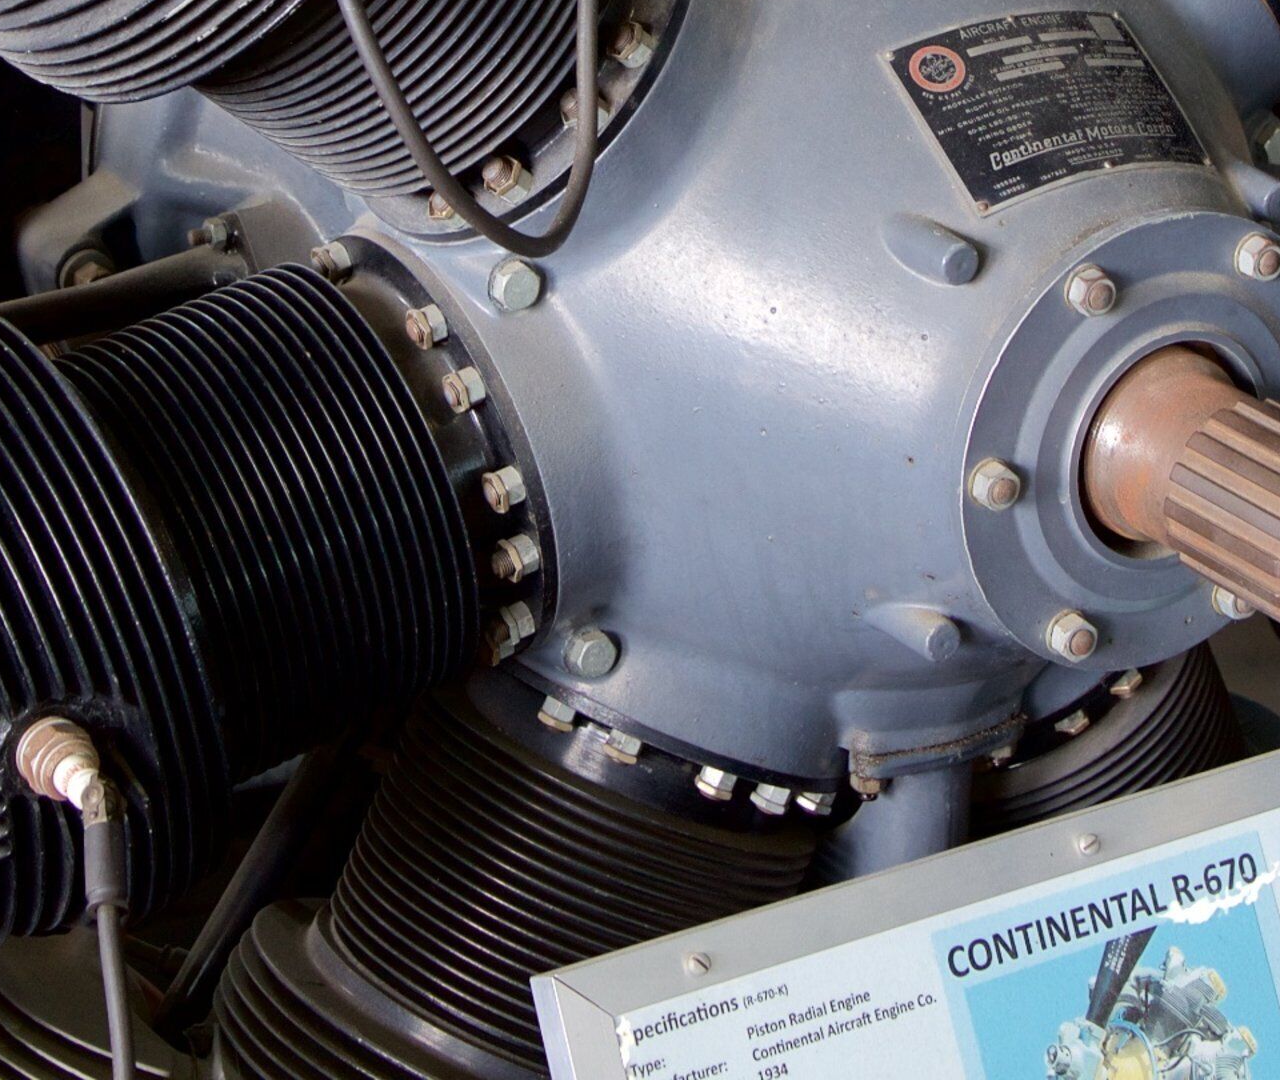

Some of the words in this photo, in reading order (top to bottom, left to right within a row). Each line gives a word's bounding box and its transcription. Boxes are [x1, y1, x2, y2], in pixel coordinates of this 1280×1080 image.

[959, 17, 1017, 41] AIRCRAFT
[1021, 13, 1063, 27] ENGINE
[957, 111, 995, 128] CRUISING
[989, 128, 1083, 171] Continental
[1084, 123, 1135, 141] Motors
[947, 883, 1168, 978] CONTINENTAL
[1171, 852, 1257, 906] R-670
[629, 1057, 667, 1079] Type:
[746, 1018, 787, 1040] Piston
[788, 1003, 828, 1027] Radial
[829, 990, 871, 1020] Engine
[632, 997, 739, 1046] pecifications
[742, 984, 789, 1009] (R-670-K)
[751, 1029, 826, 1062] Continental
[827, 1011, 872, 1038] Aircraft
[874, 999, 916, 1026] Engine
[917, 993, 938, 1009] Co.
[758, 1062, 789, 1080] 1934
